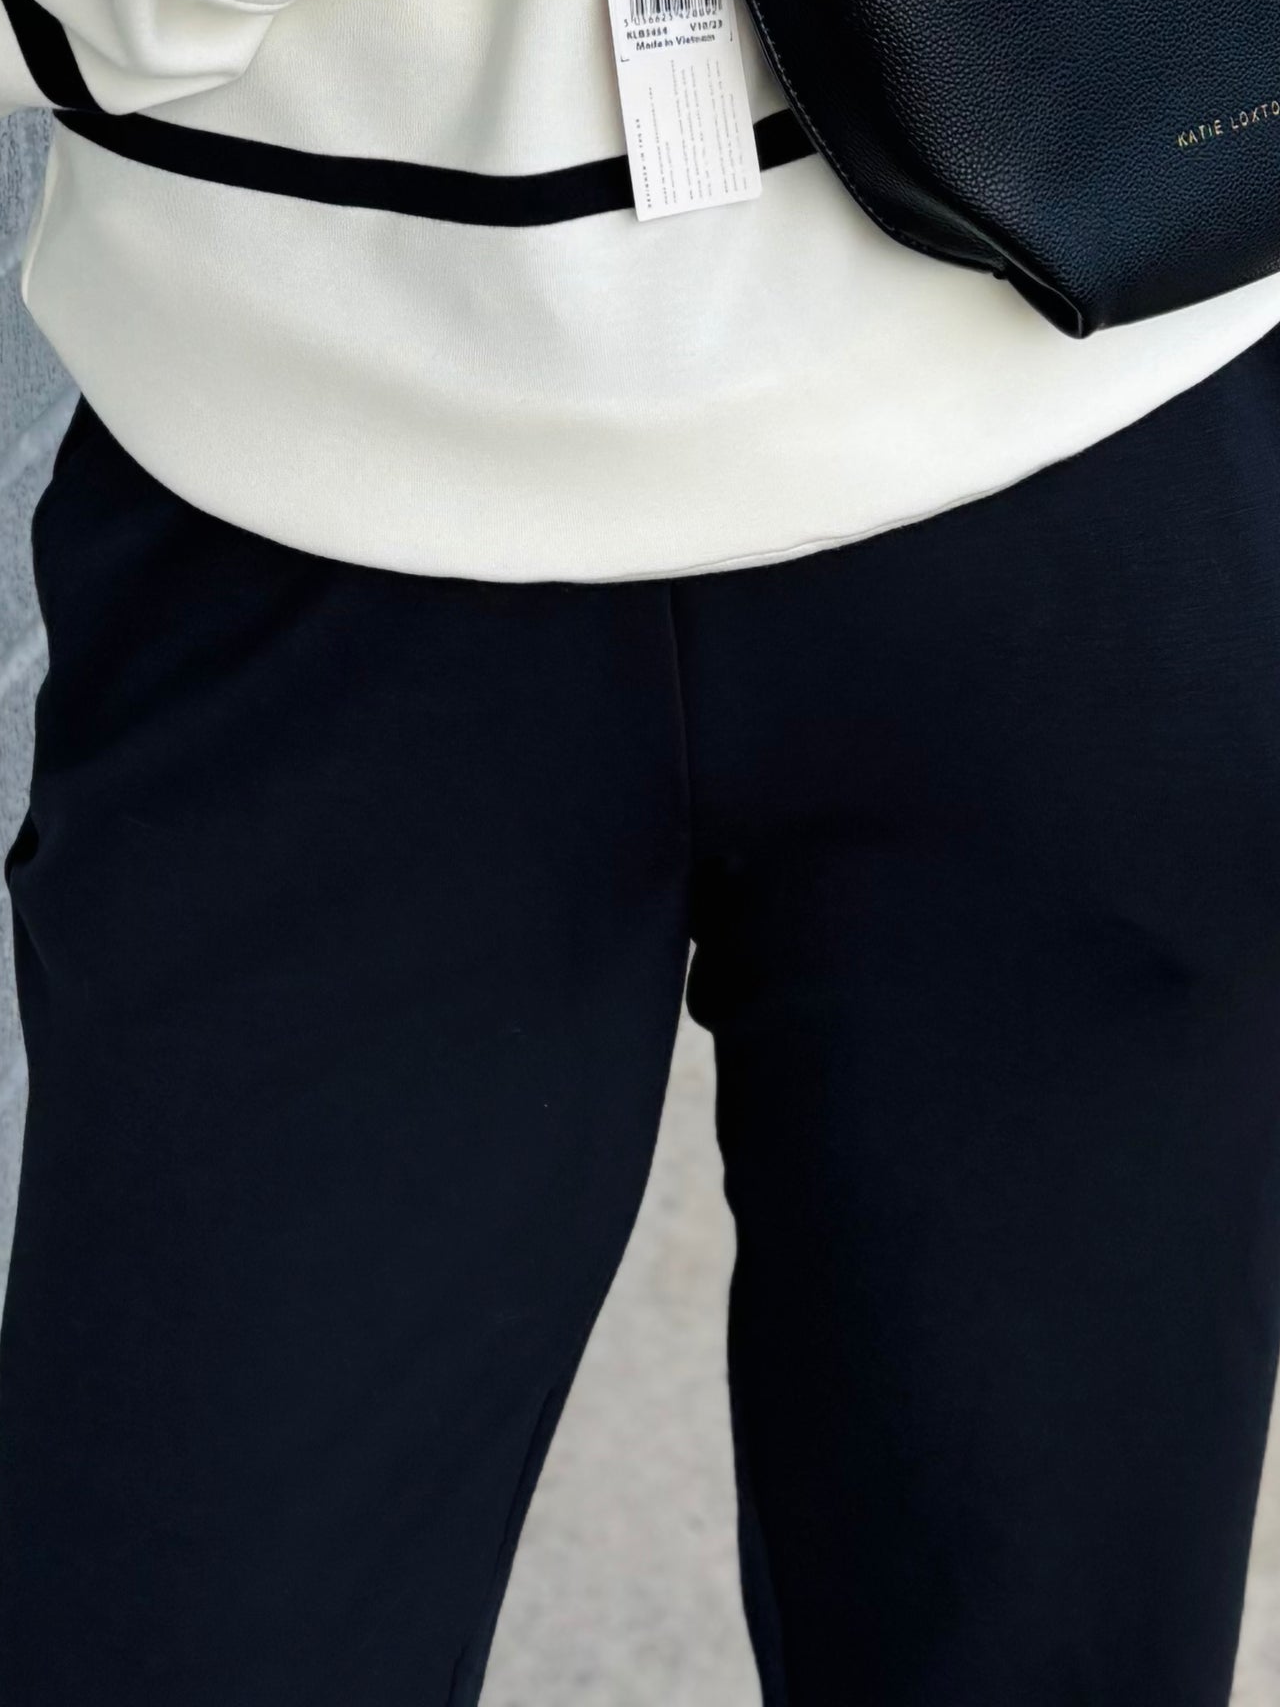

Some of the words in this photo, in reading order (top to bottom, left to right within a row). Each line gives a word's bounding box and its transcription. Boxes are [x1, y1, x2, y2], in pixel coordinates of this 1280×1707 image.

[636, 39, 663, 51] Made
[675, 34, 716, 46] Vietnam
[1177, 119, 1224, 147] KATIE
